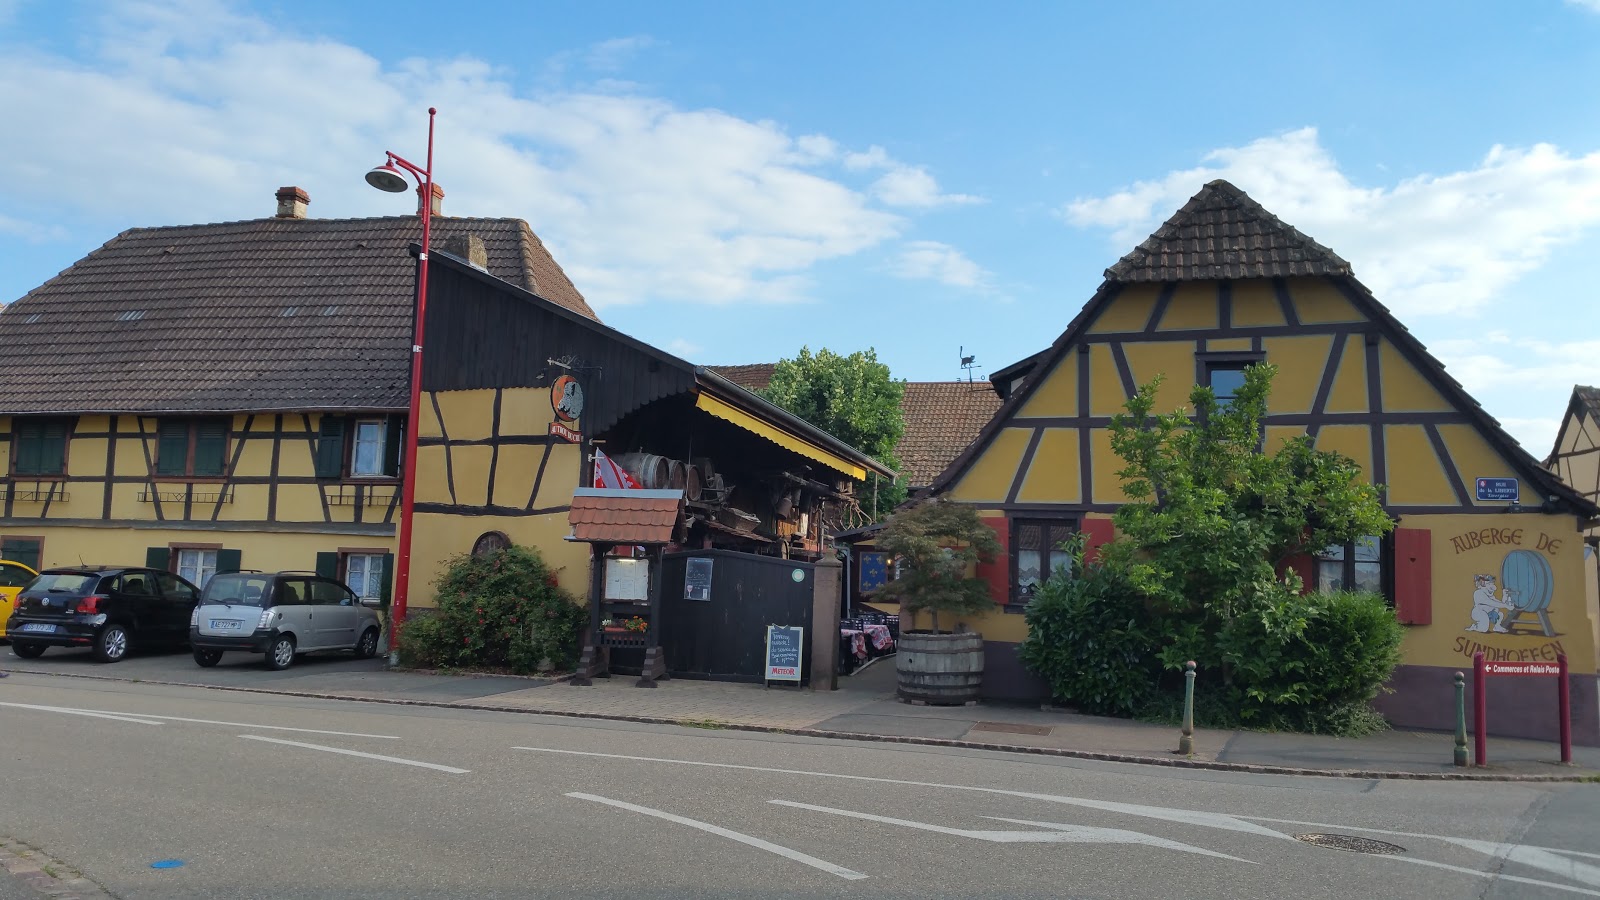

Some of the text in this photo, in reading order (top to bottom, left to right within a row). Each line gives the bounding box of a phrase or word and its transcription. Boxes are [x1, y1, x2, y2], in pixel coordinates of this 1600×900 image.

[1450, 528, 1562, 555] AUBERGE DE
[1453, 637, 1566, 661] SUNDHOFFEN
[771, 667, 795, 675] METEOR
[1493, 664, 1560, 673] Commerces et Relais Poste
